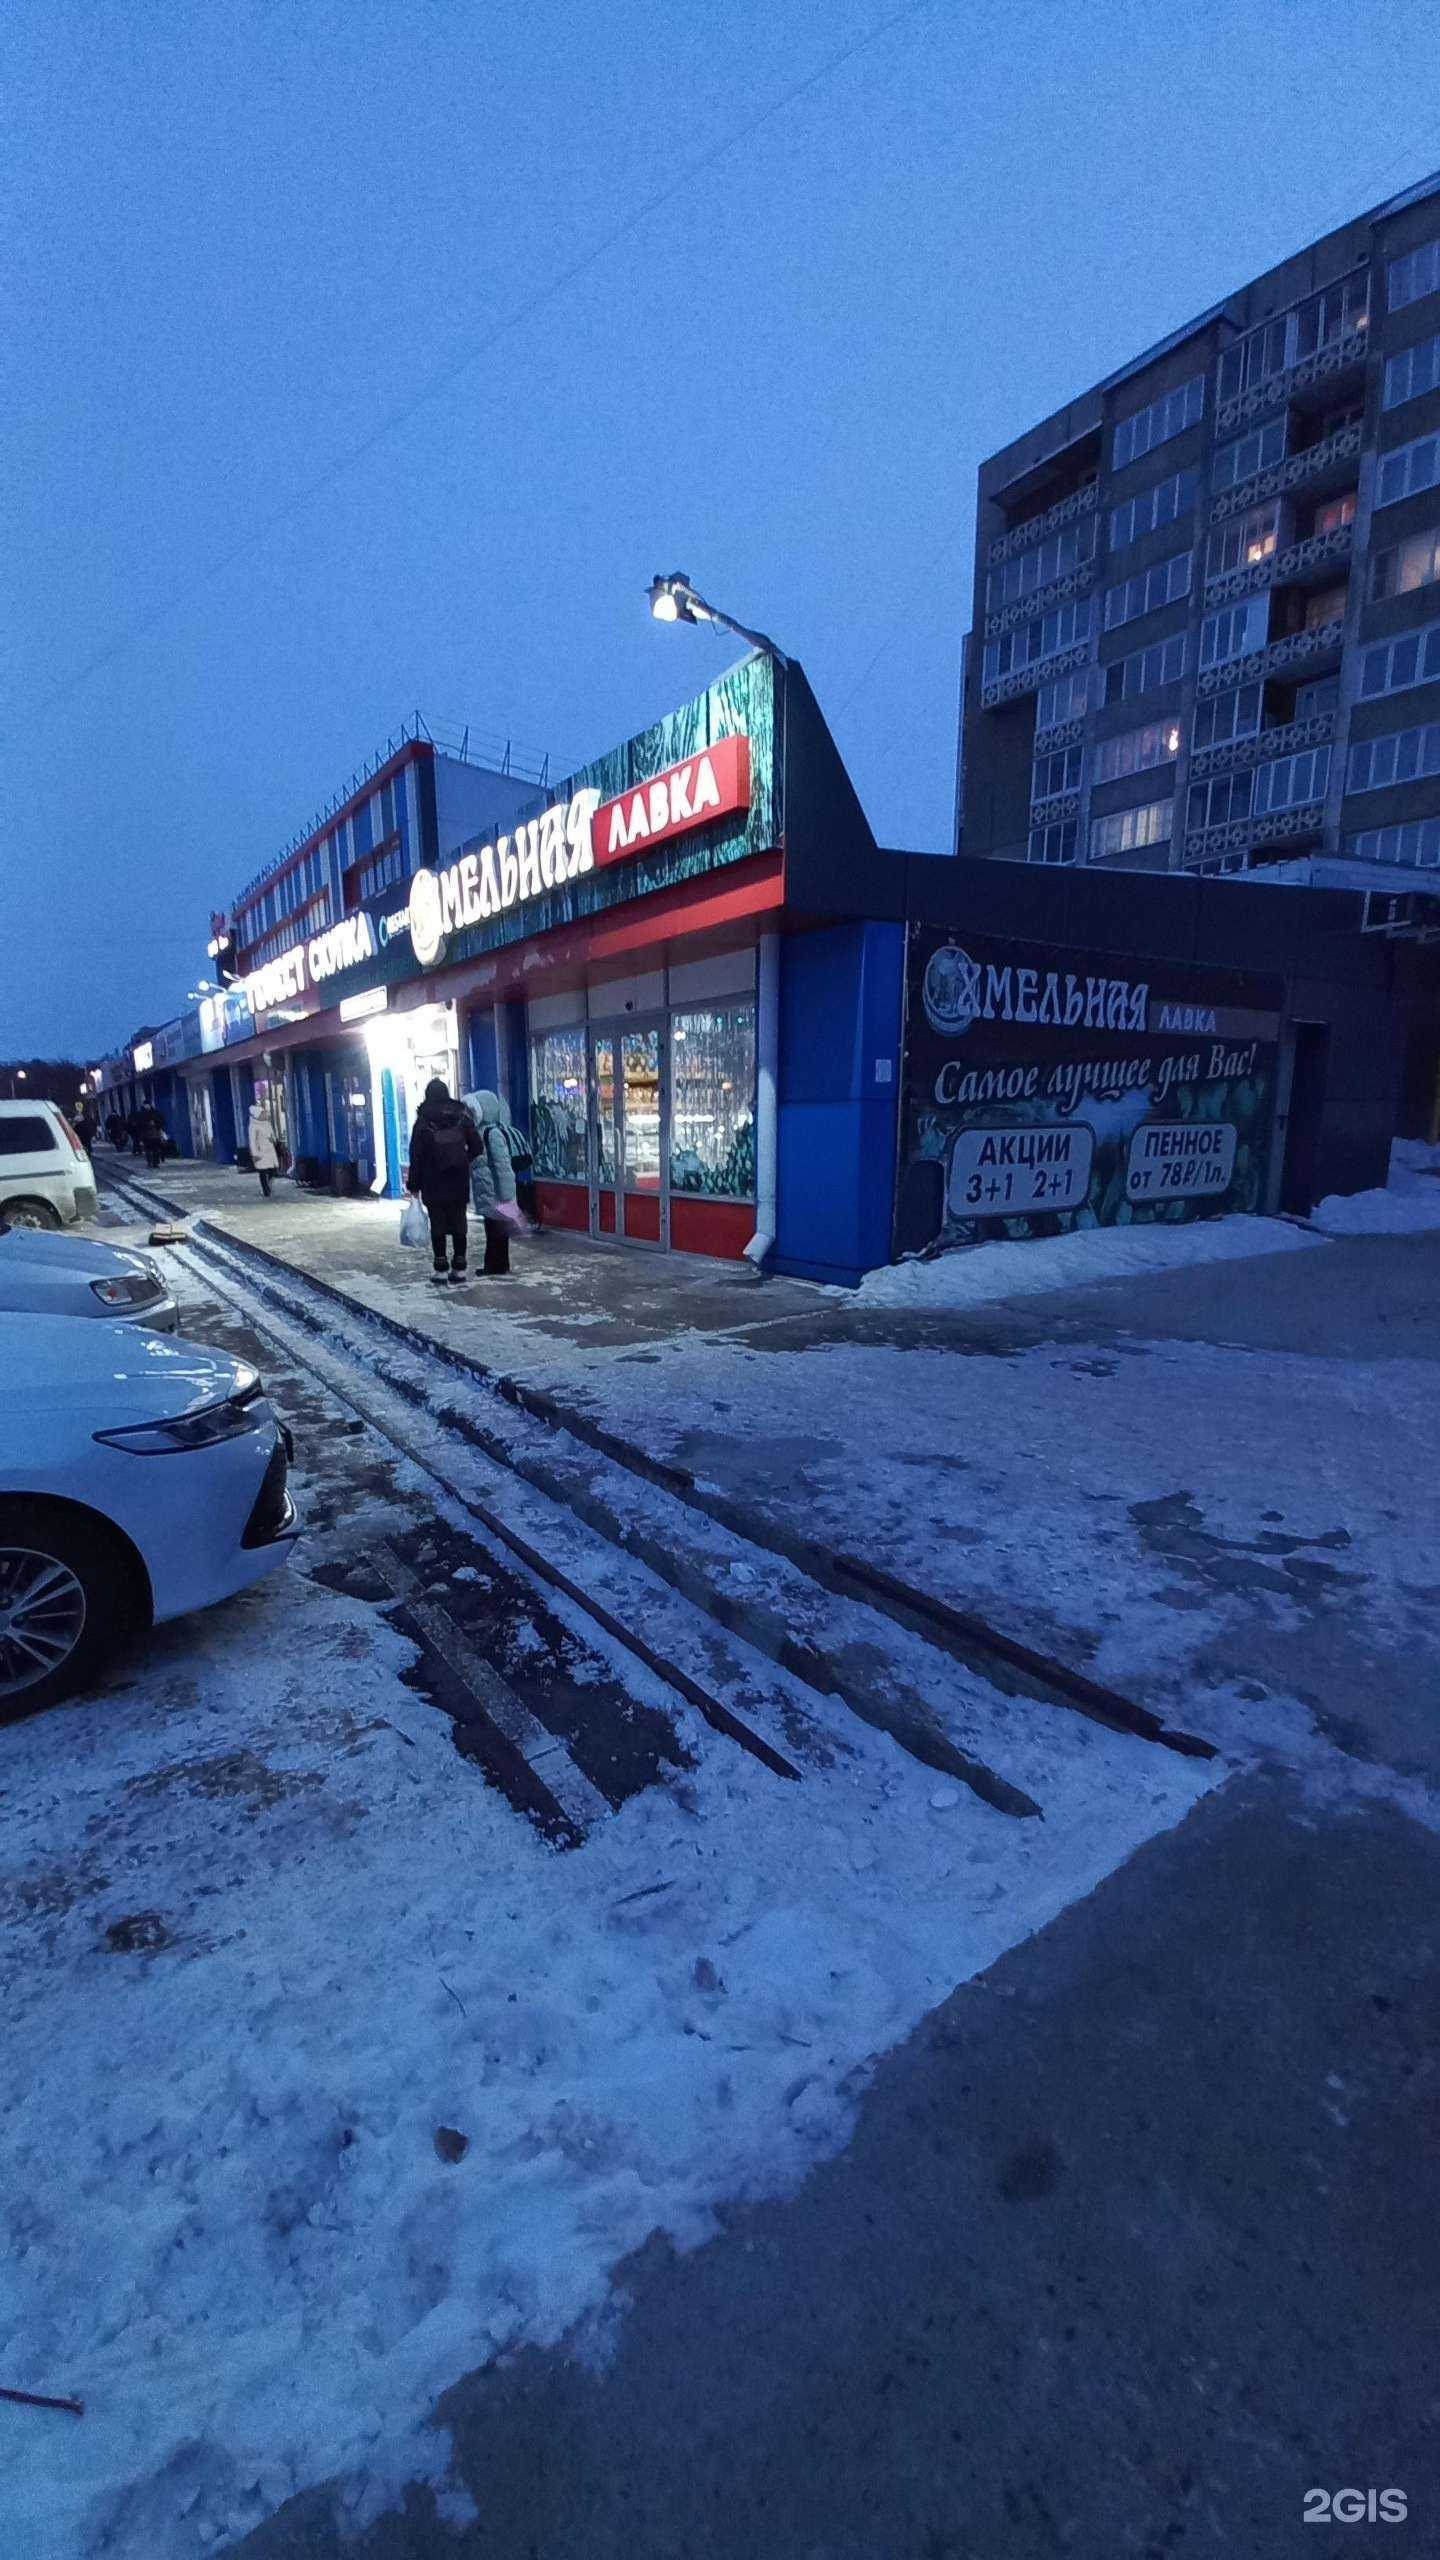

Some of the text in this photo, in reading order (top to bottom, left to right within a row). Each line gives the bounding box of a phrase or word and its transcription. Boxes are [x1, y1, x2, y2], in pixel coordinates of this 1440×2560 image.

[608, 757, 720, 853] ЛАВКА
[957, 962, 1217, 1033] ХМЕЛЬНАЯ ЛАВКА
[934, 1042, 1258, 1112] Самое лучшее для Вас!
[978, 1134, 1071, 1170] АКЦИИ
[1144, 1129, 1222, 1158] ПЕННОЕ
[966, 1169, 1073, 1203] 3+1 2+1
[1130, 1170, 1152, 1190] от
